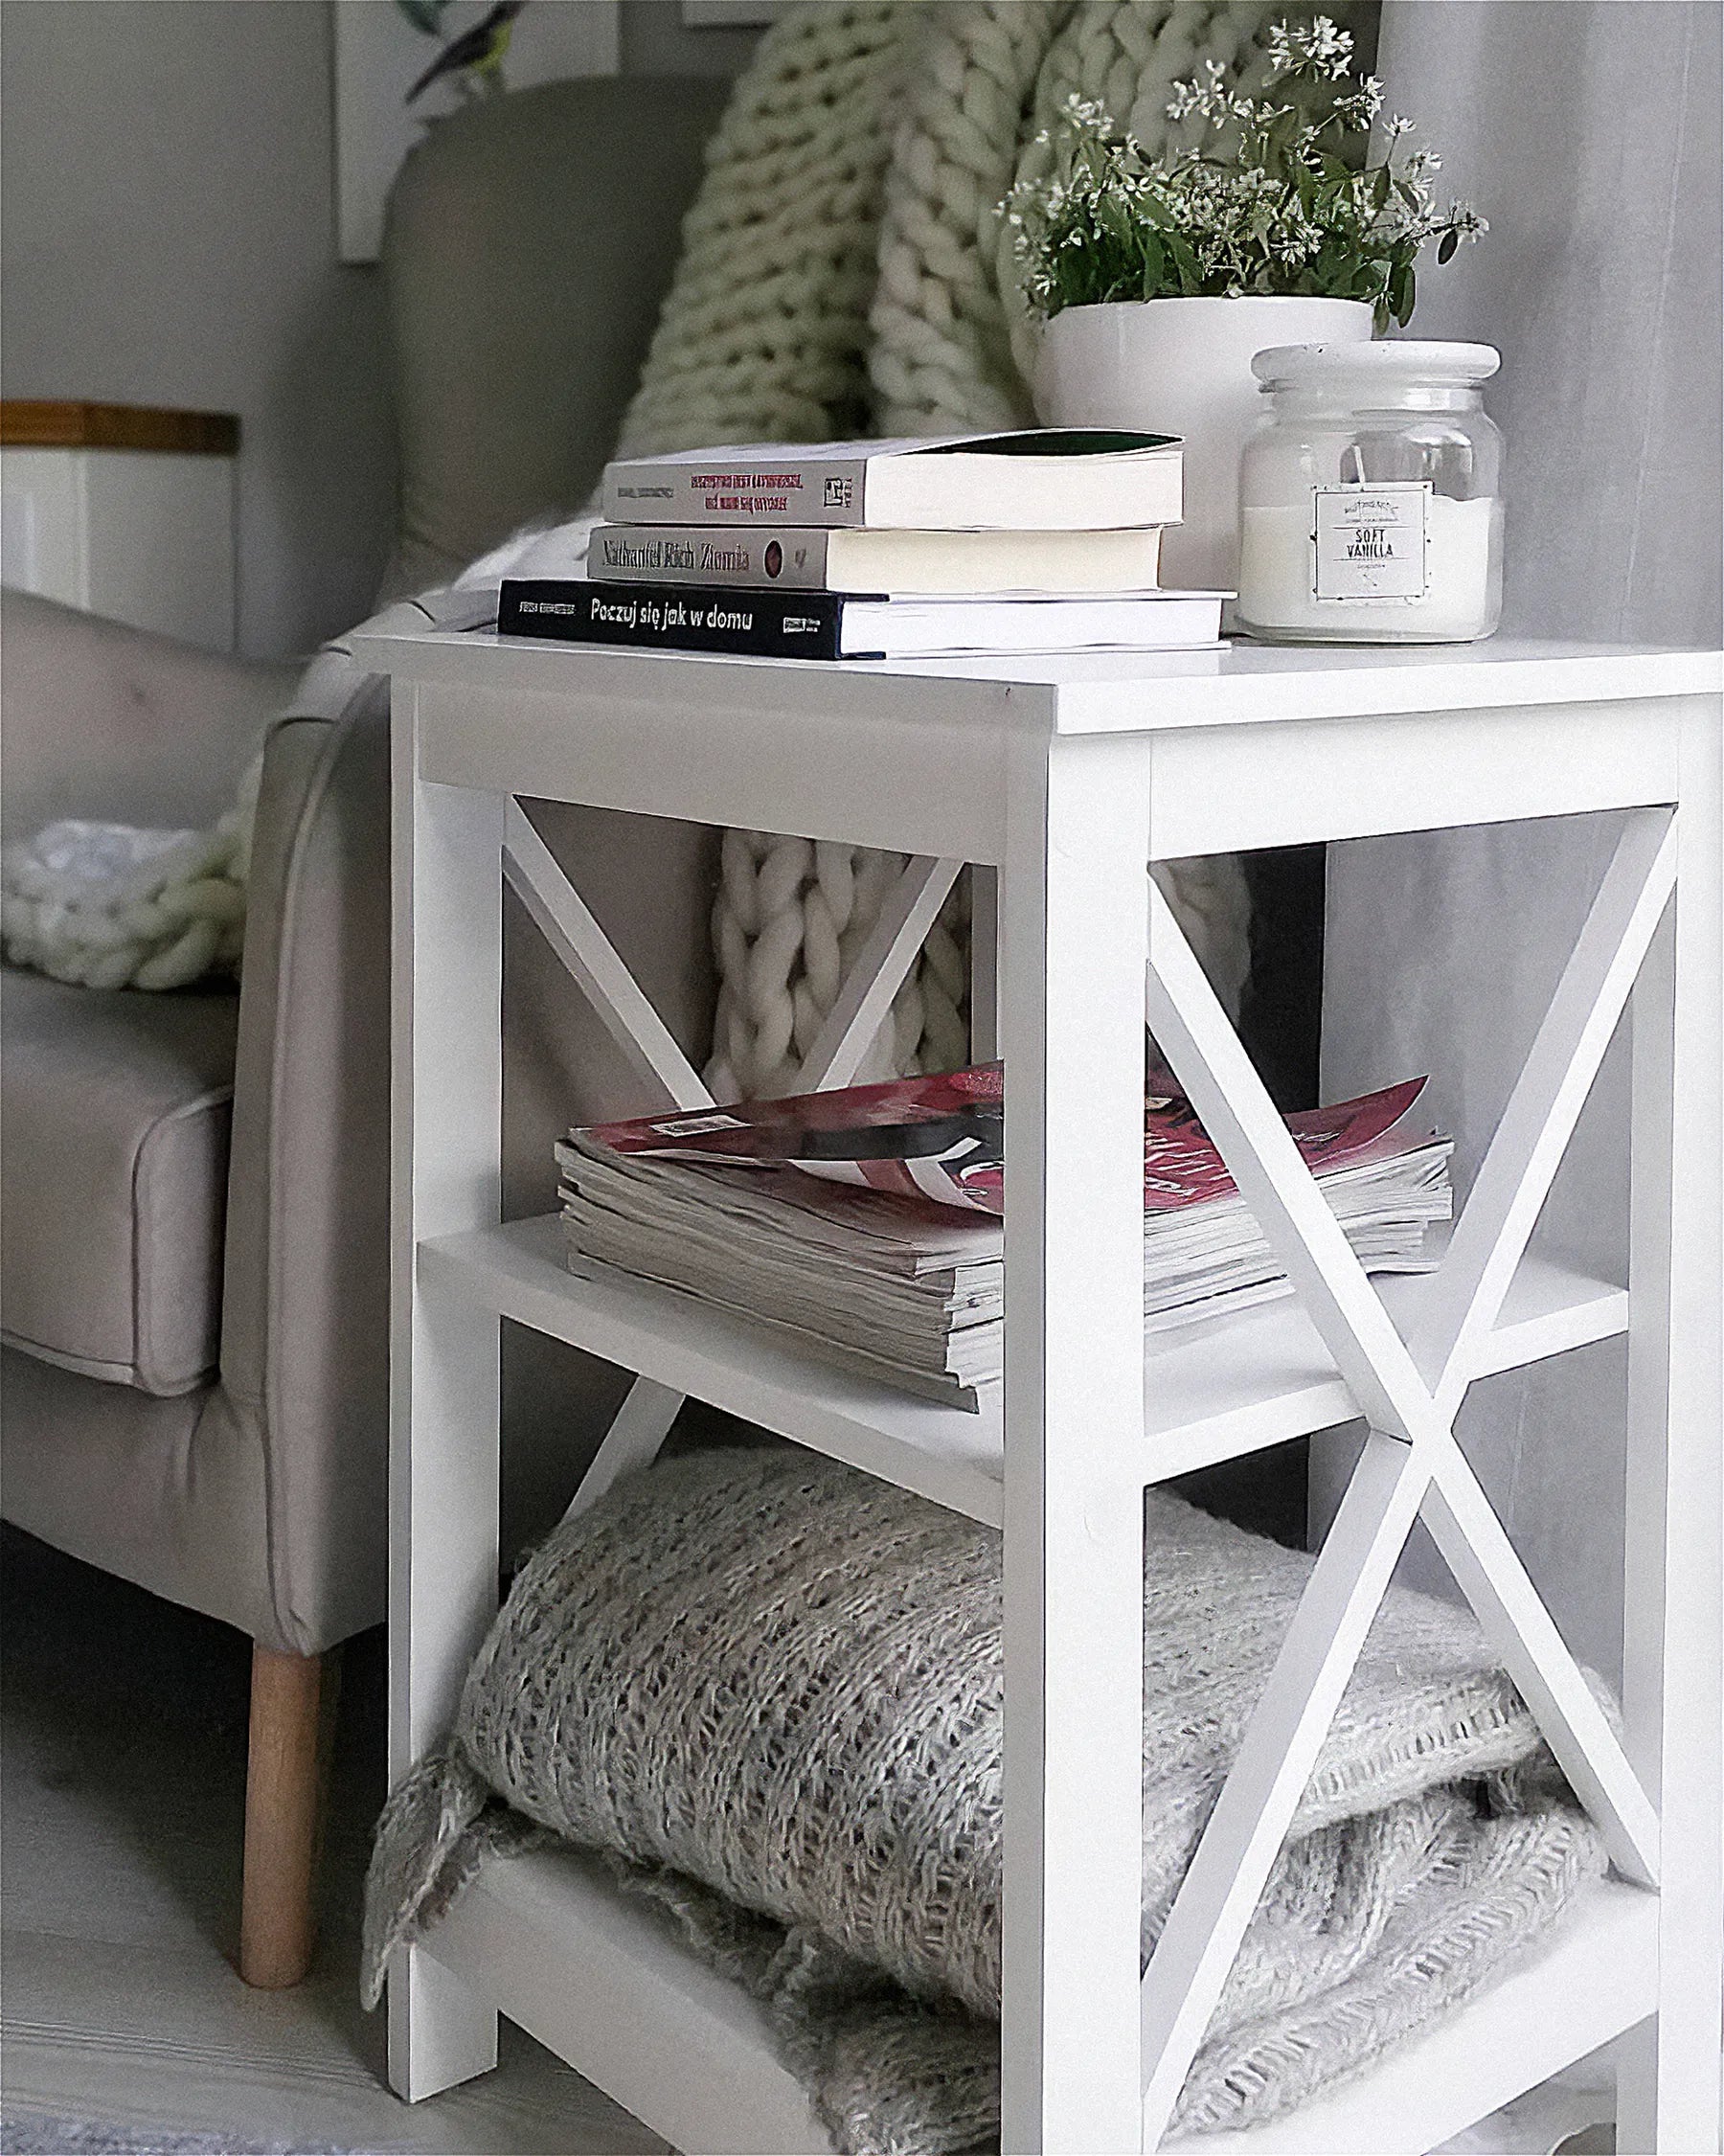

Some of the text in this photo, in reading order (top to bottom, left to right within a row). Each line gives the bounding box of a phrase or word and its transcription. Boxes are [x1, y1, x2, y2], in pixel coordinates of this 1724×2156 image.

[1355, 529, 1385, 543] SOFT
[1347, 543, 1395, 558] VANILLA
[591, 598, 638, 628] Poczuj
[640, 601, 660, 630] się
[661, 601, 687, 631] jak
[690, 611, 704, 626] w
[707, 603, 753, 630] domu
